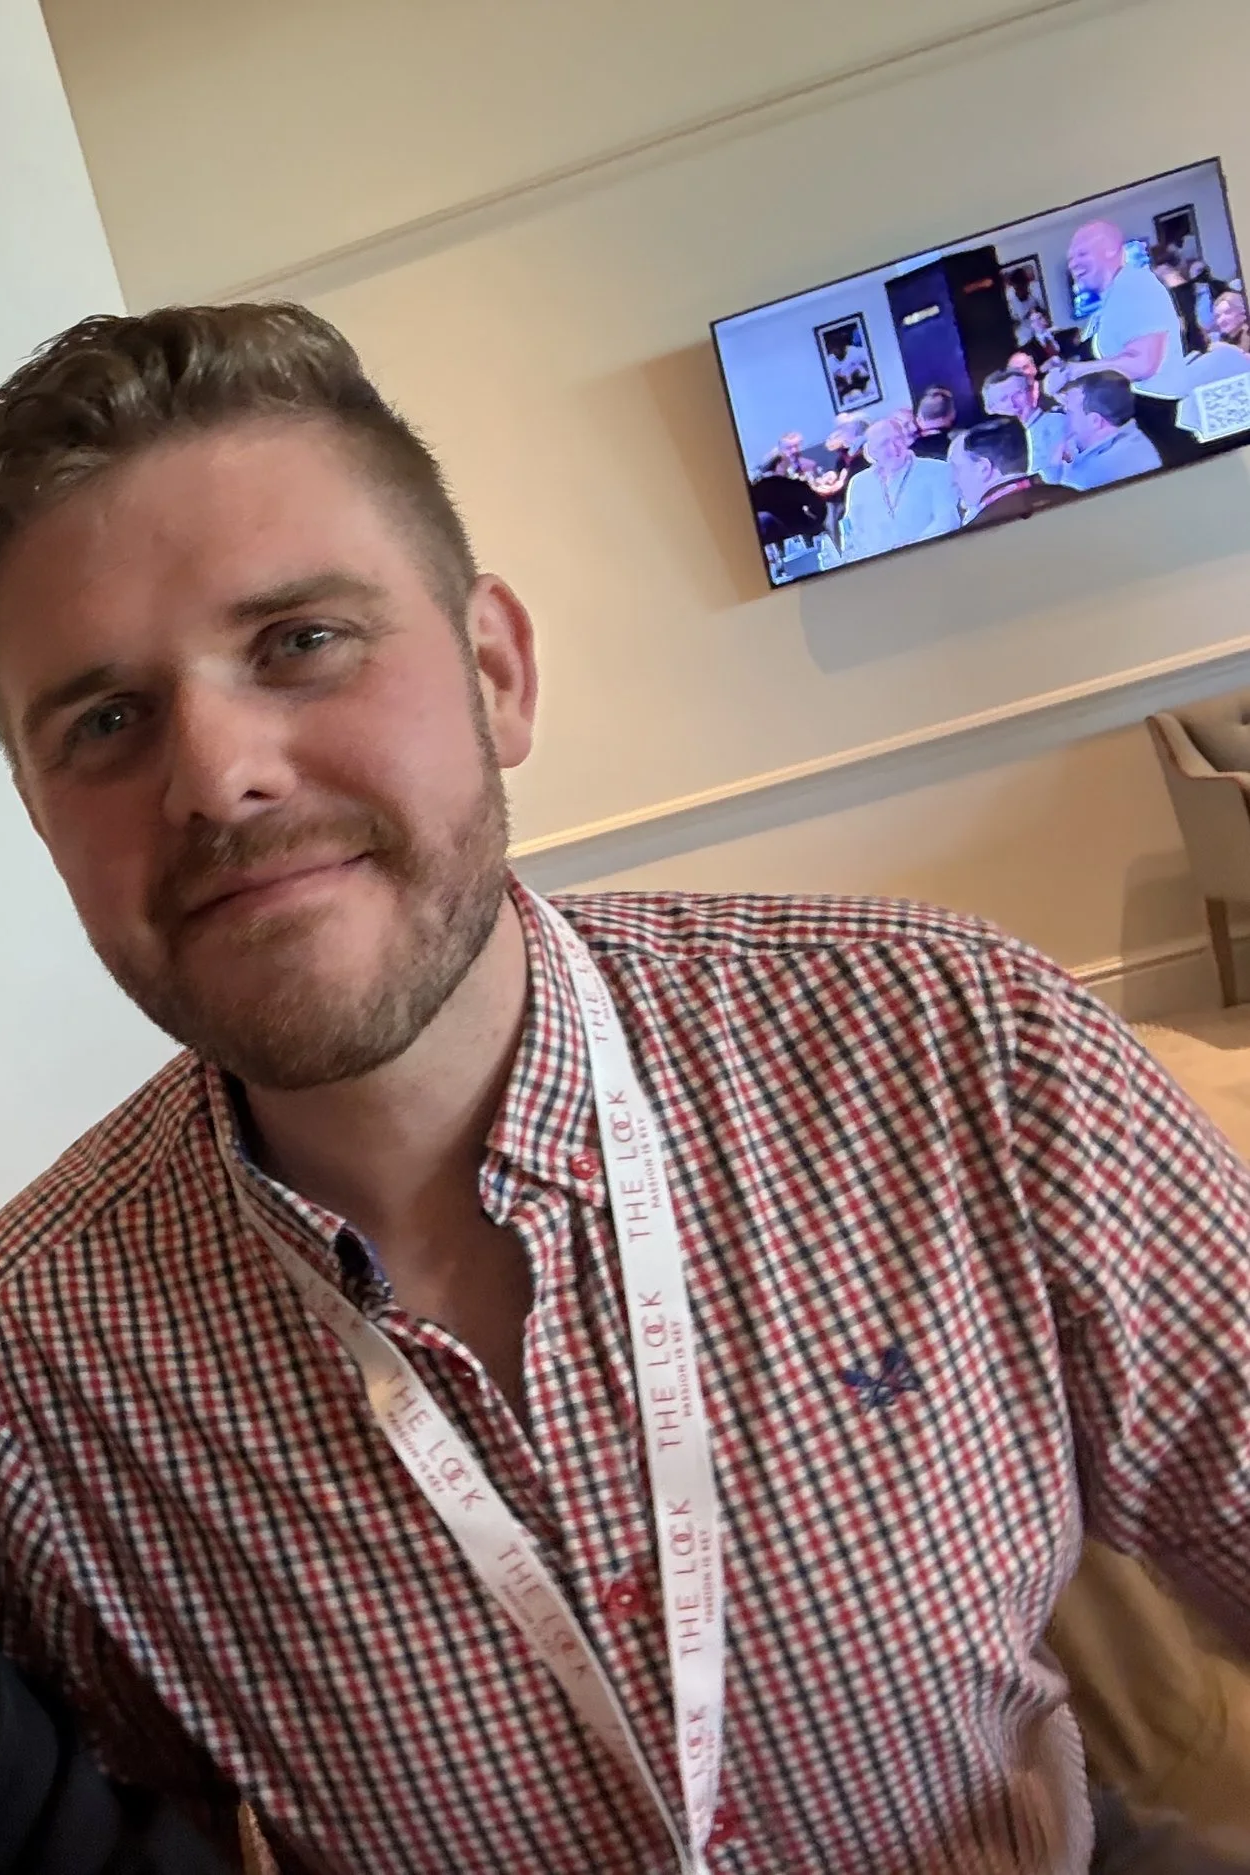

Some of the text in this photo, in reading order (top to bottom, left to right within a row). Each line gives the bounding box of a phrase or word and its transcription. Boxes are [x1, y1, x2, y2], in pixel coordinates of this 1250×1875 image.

[604, 1089, 652, 1244] THE LOCK
[386, 1367, 489, 1512] THE LOCK
[637, 1290, 683, 1453] THE LOCK
[498, 1540, 542, 1597] THE
[666, 1498, 703, 1661] THE LOCK
